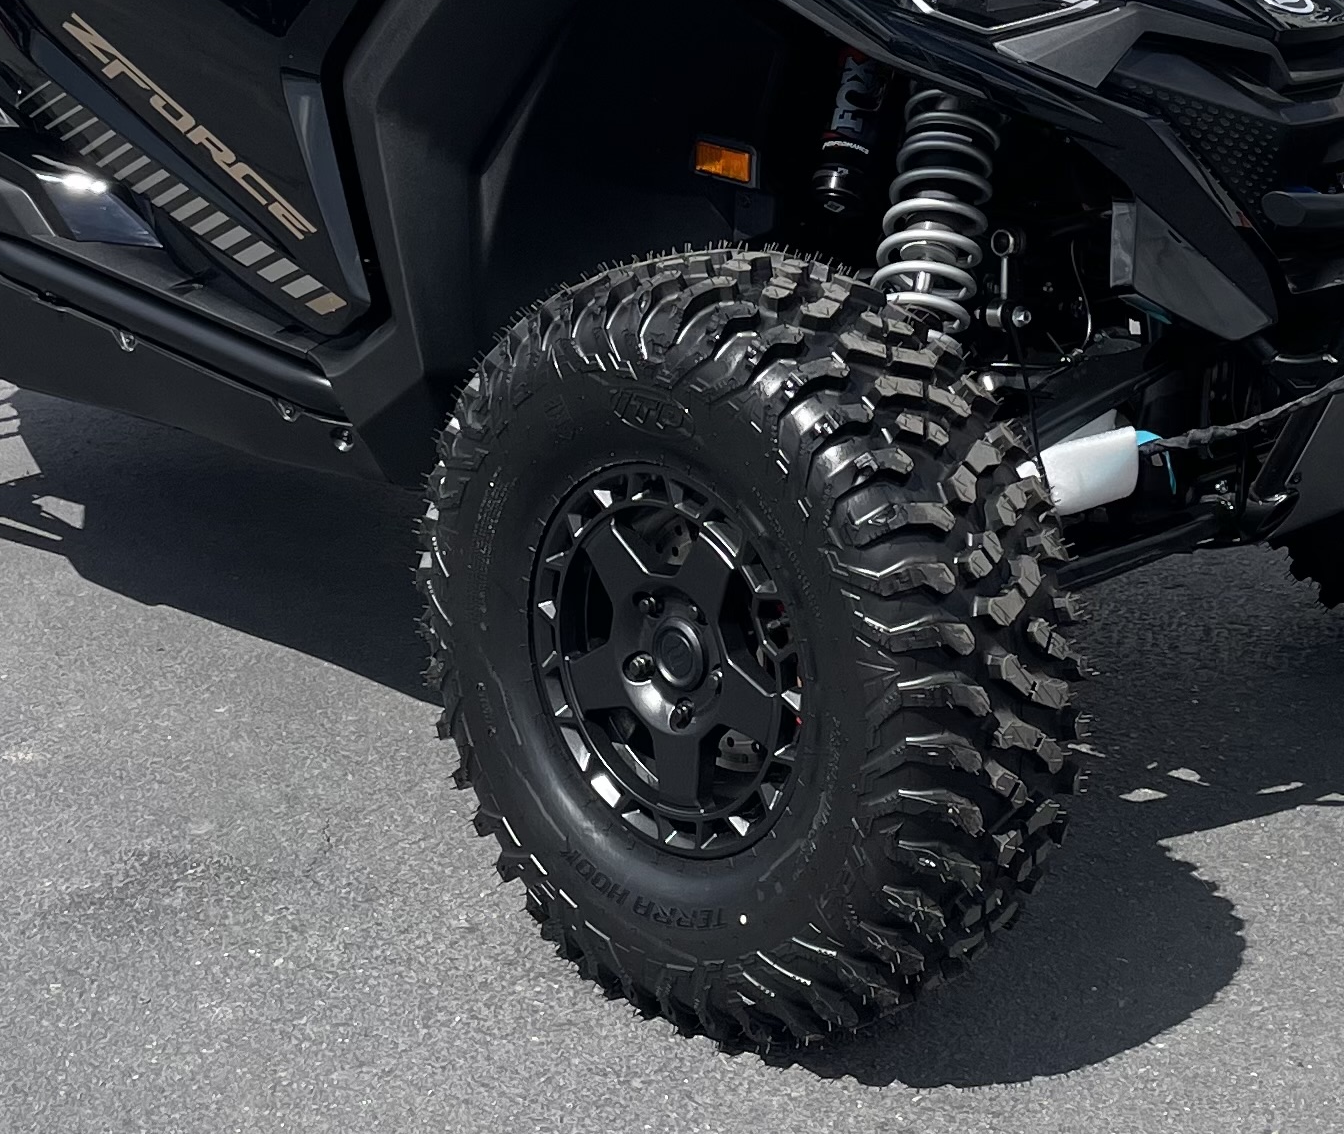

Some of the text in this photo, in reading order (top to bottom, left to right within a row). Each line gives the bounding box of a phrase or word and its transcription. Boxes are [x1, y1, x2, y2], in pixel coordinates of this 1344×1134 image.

[62, 12, 317, 240] ZFORCE
[830, 56, 882, 133] FOX
[613, 391, 685, 430] ITP
[560, 834, 728, 930] TERRA HOOK
